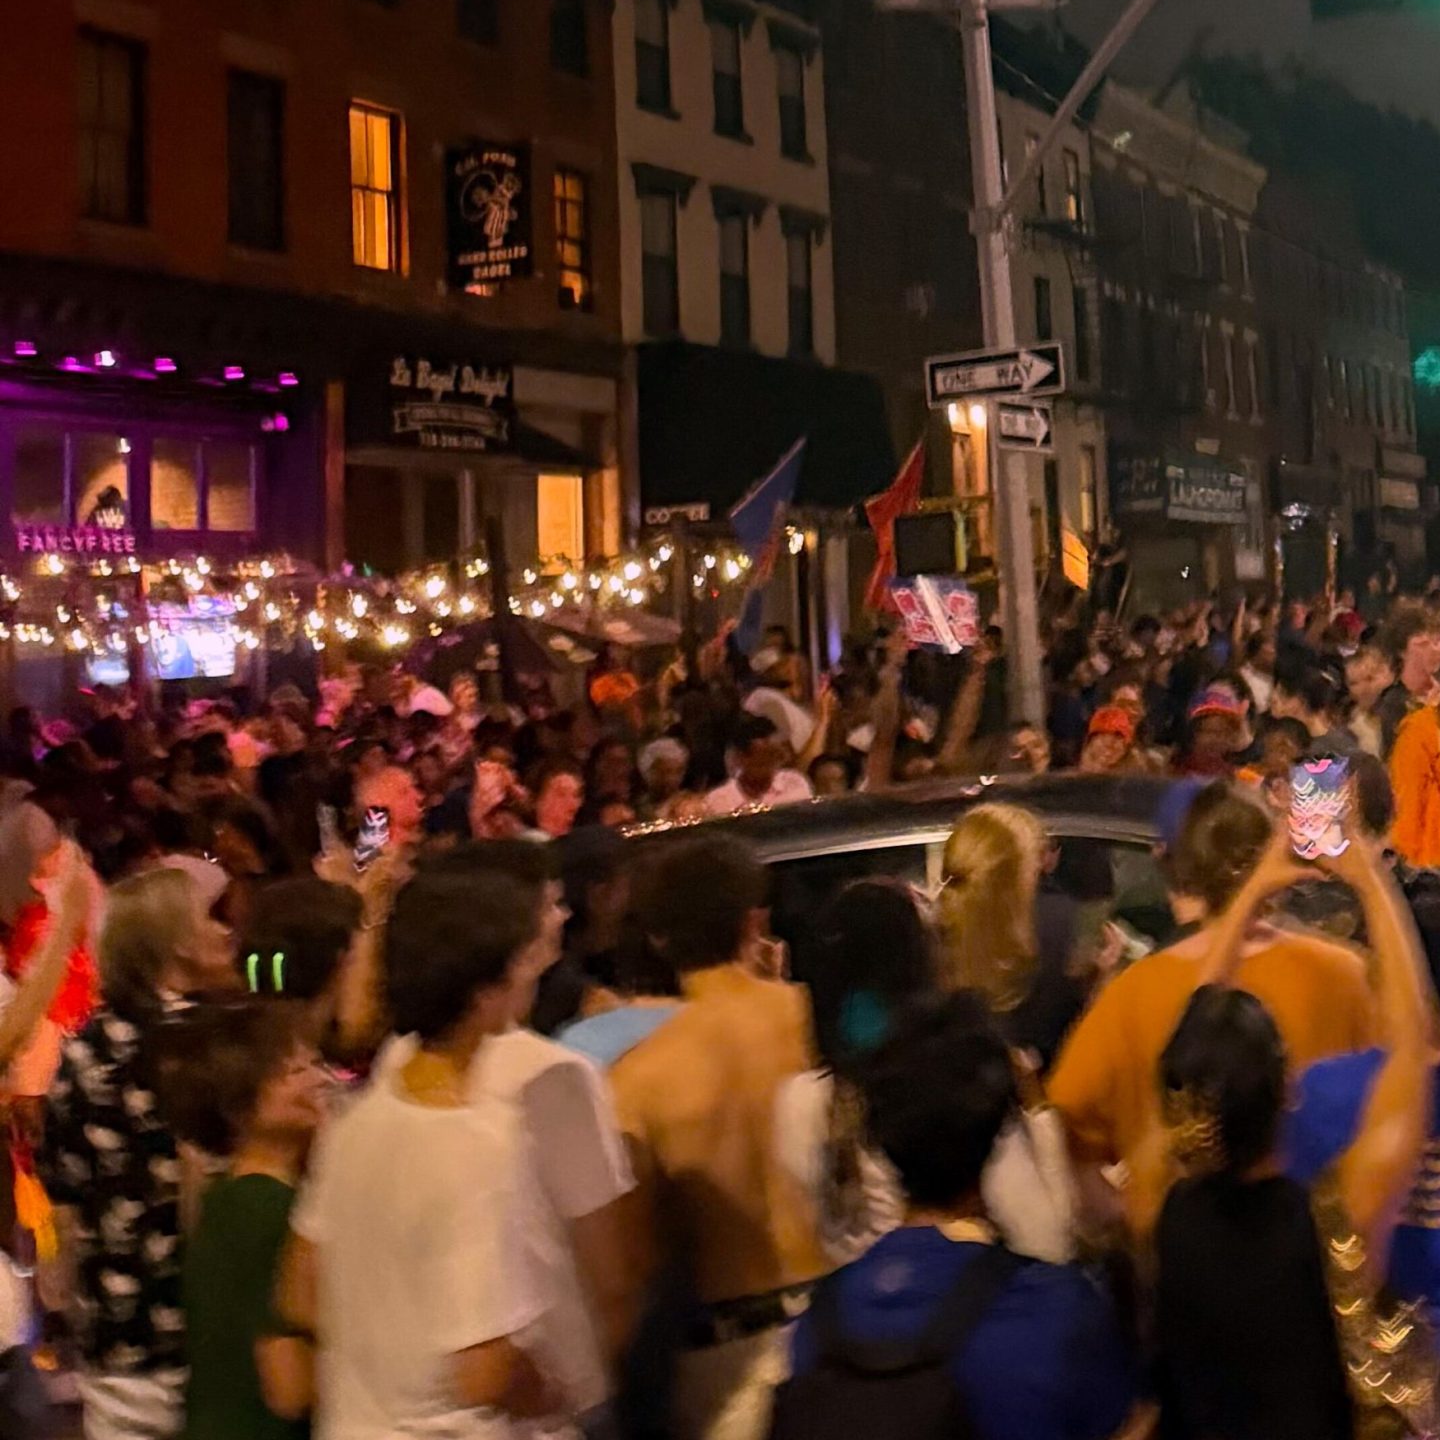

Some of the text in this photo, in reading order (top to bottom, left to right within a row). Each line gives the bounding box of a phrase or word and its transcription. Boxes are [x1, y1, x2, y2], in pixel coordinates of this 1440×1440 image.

[942, 361, 1034, 391] ONE WAY
[17, 532, 136, 553] FANCYFREE
